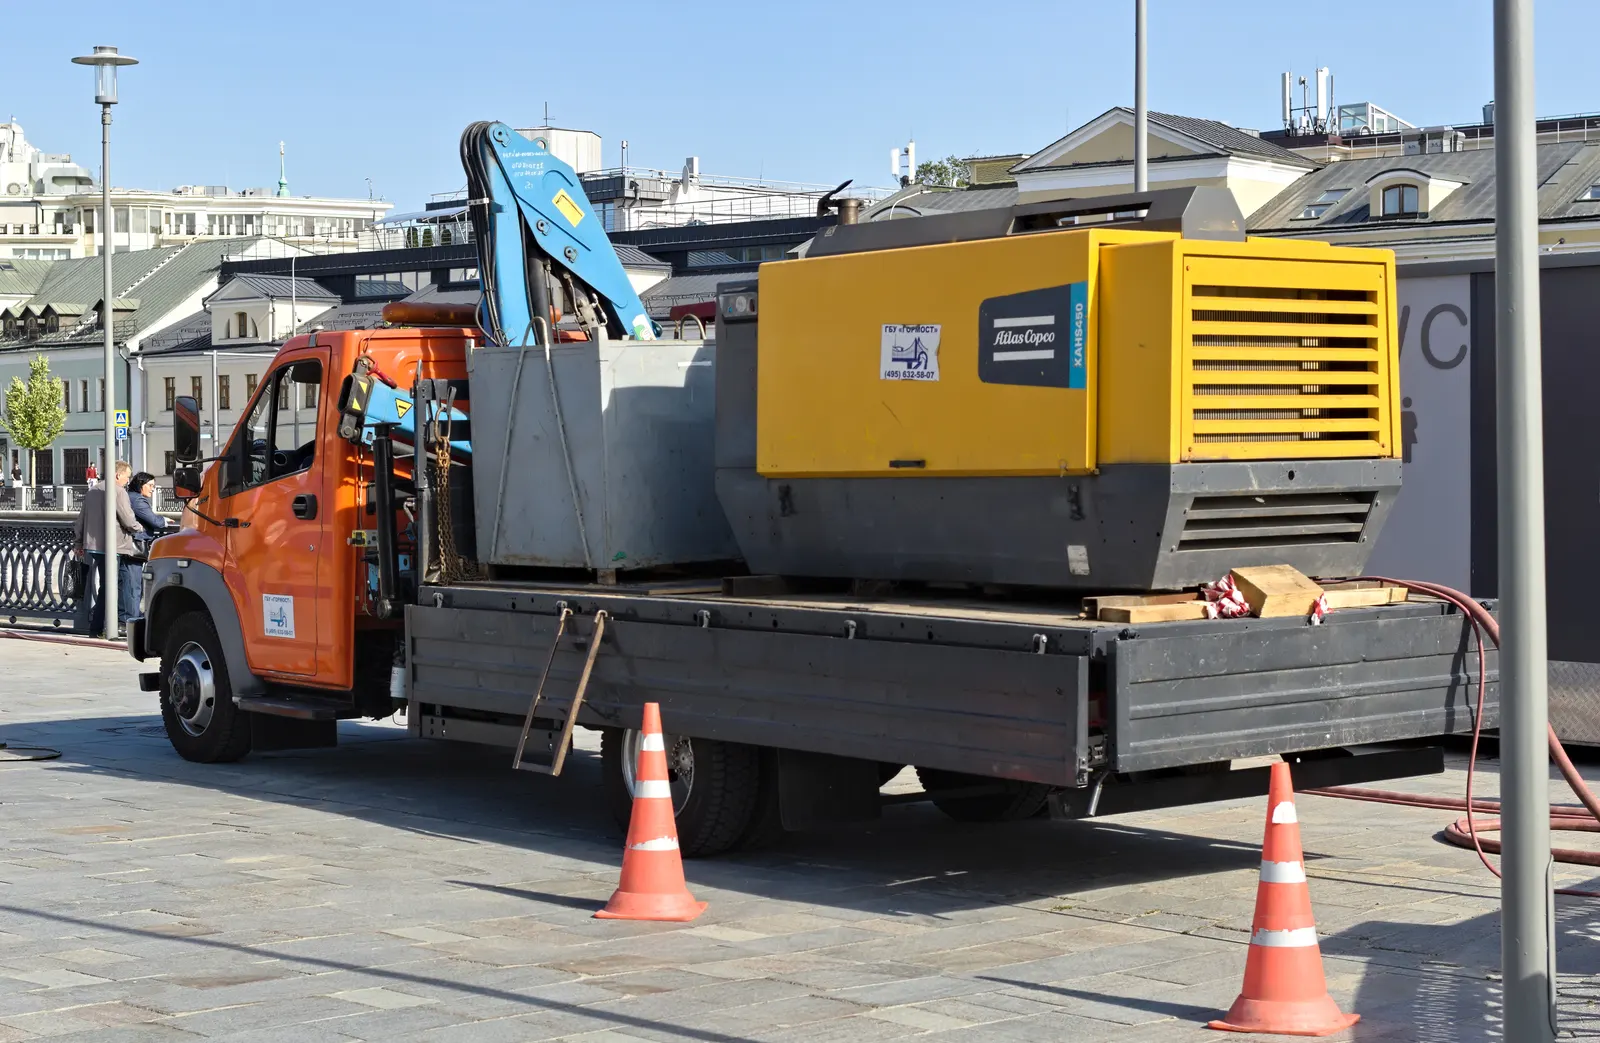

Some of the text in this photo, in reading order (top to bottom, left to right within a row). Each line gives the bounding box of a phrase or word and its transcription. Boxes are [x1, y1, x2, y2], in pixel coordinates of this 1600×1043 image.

[993, 329, 1055, 346] Atlas Copco
[1074, 303, 1083, 367] XAHS450
[884, 370, 935, 379] (495) 632-58-07
